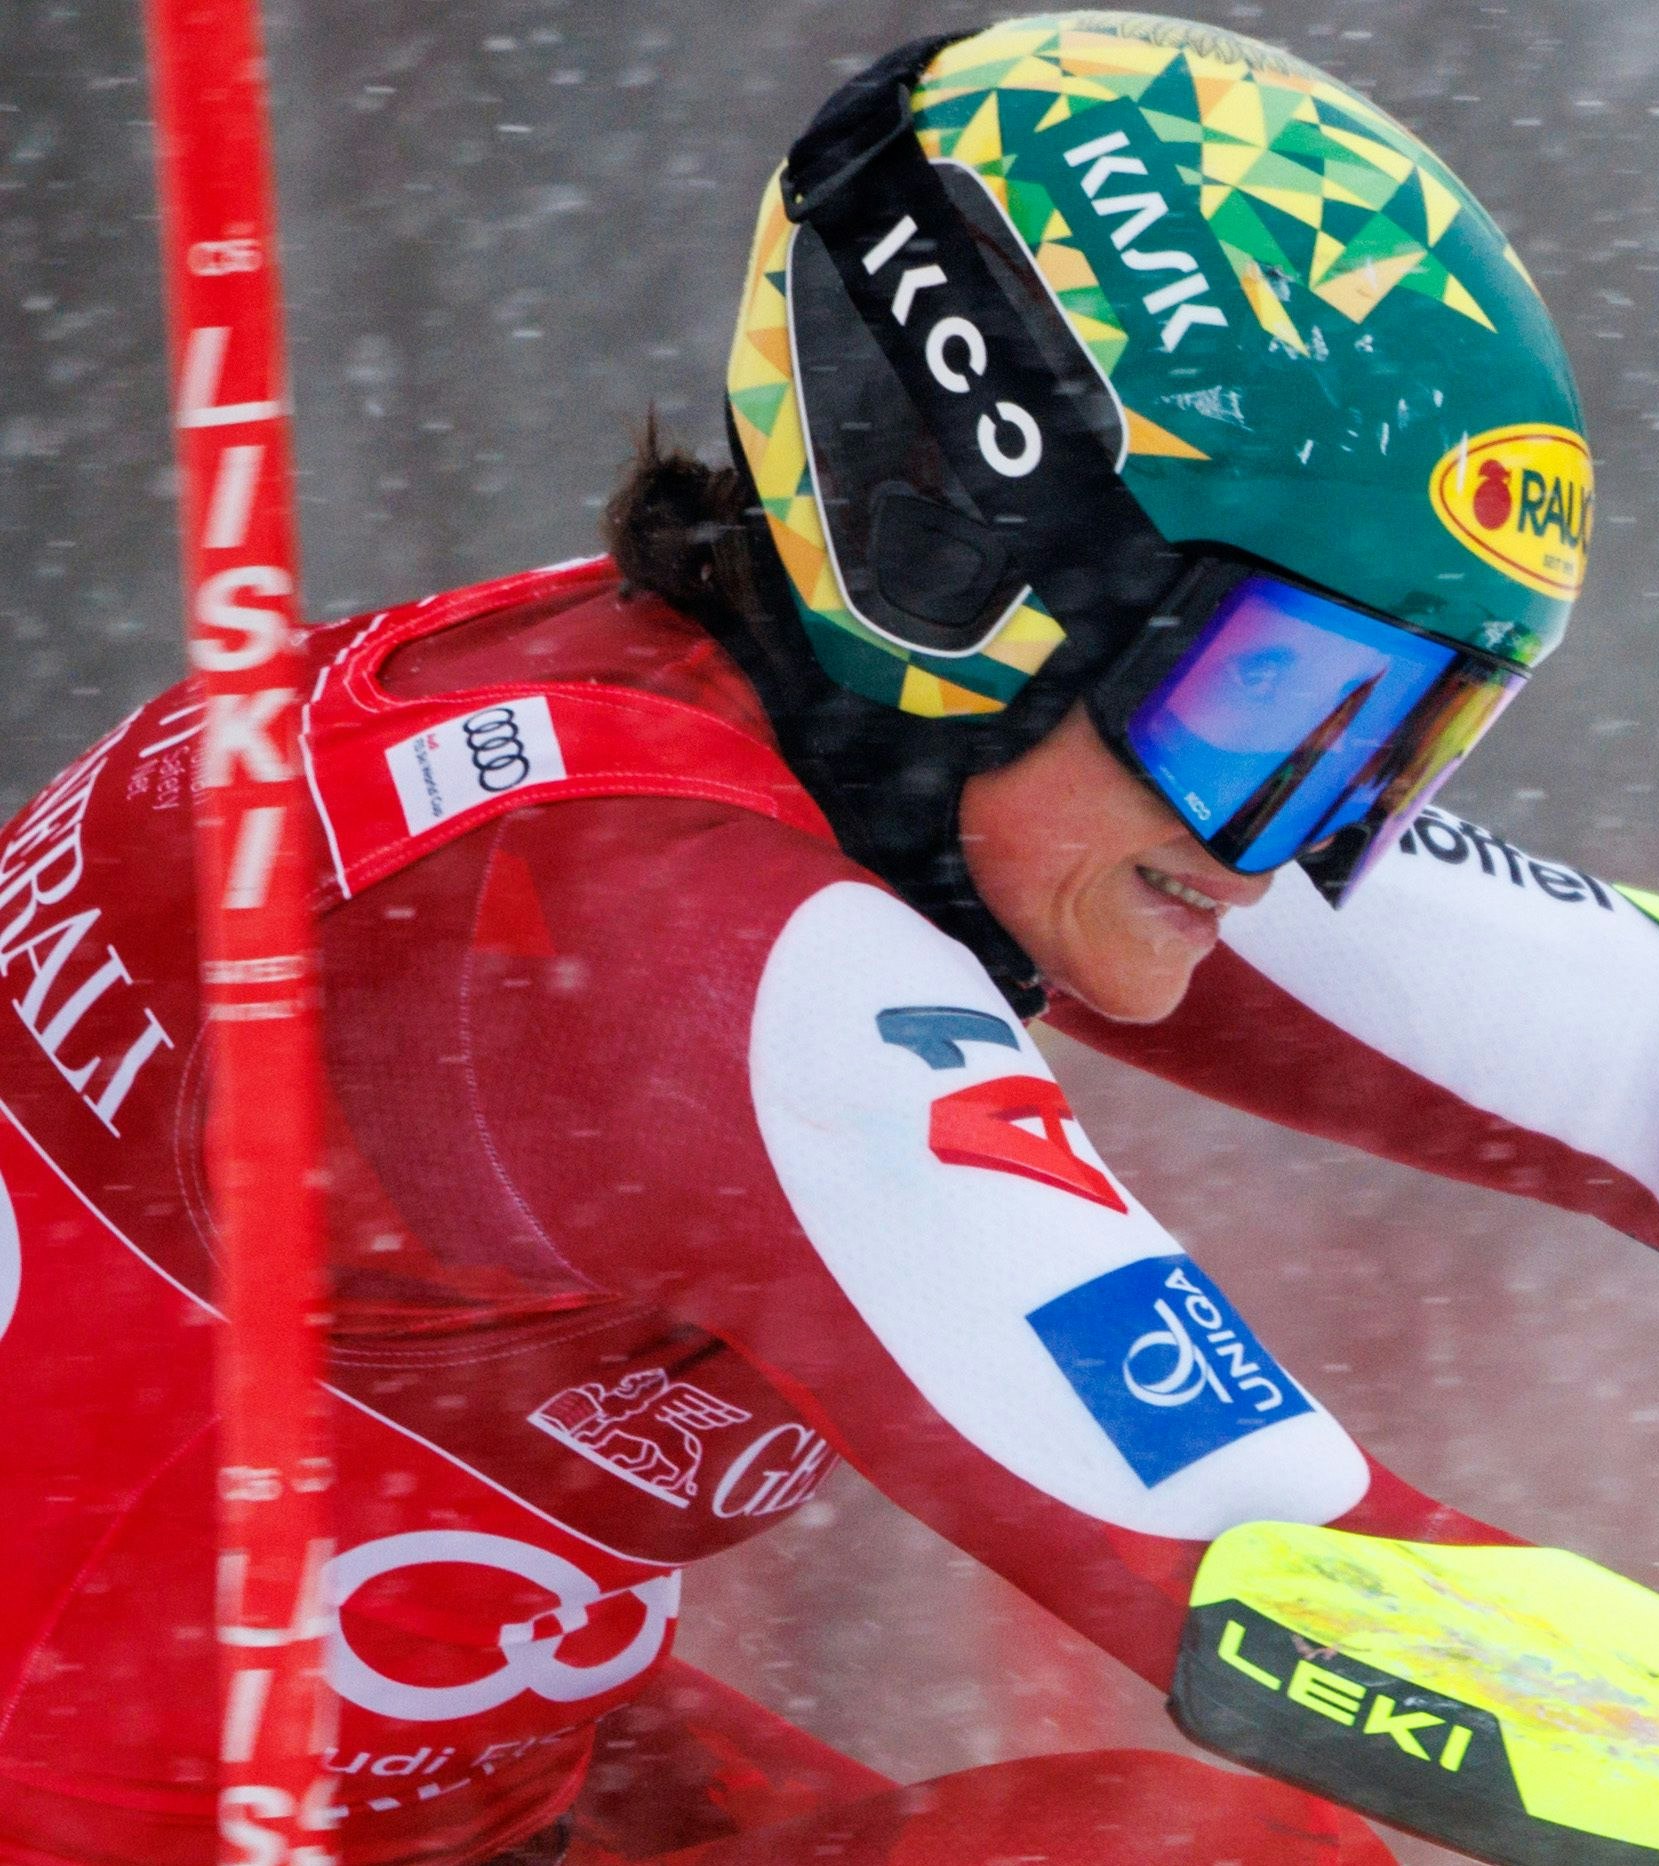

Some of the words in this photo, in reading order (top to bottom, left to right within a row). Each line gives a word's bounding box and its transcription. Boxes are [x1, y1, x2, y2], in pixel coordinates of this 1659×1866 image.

[1063, 129, 1229, 353] KASK
[861, 214, 1043, 478] KOO
[177, 326, 301, 909] LISKI
[1164, 1266, 1284, 1413] UNIQA
[322, 1746, 456, 1776] udi
[1217, 1619, 1473, 1772] LEKI
